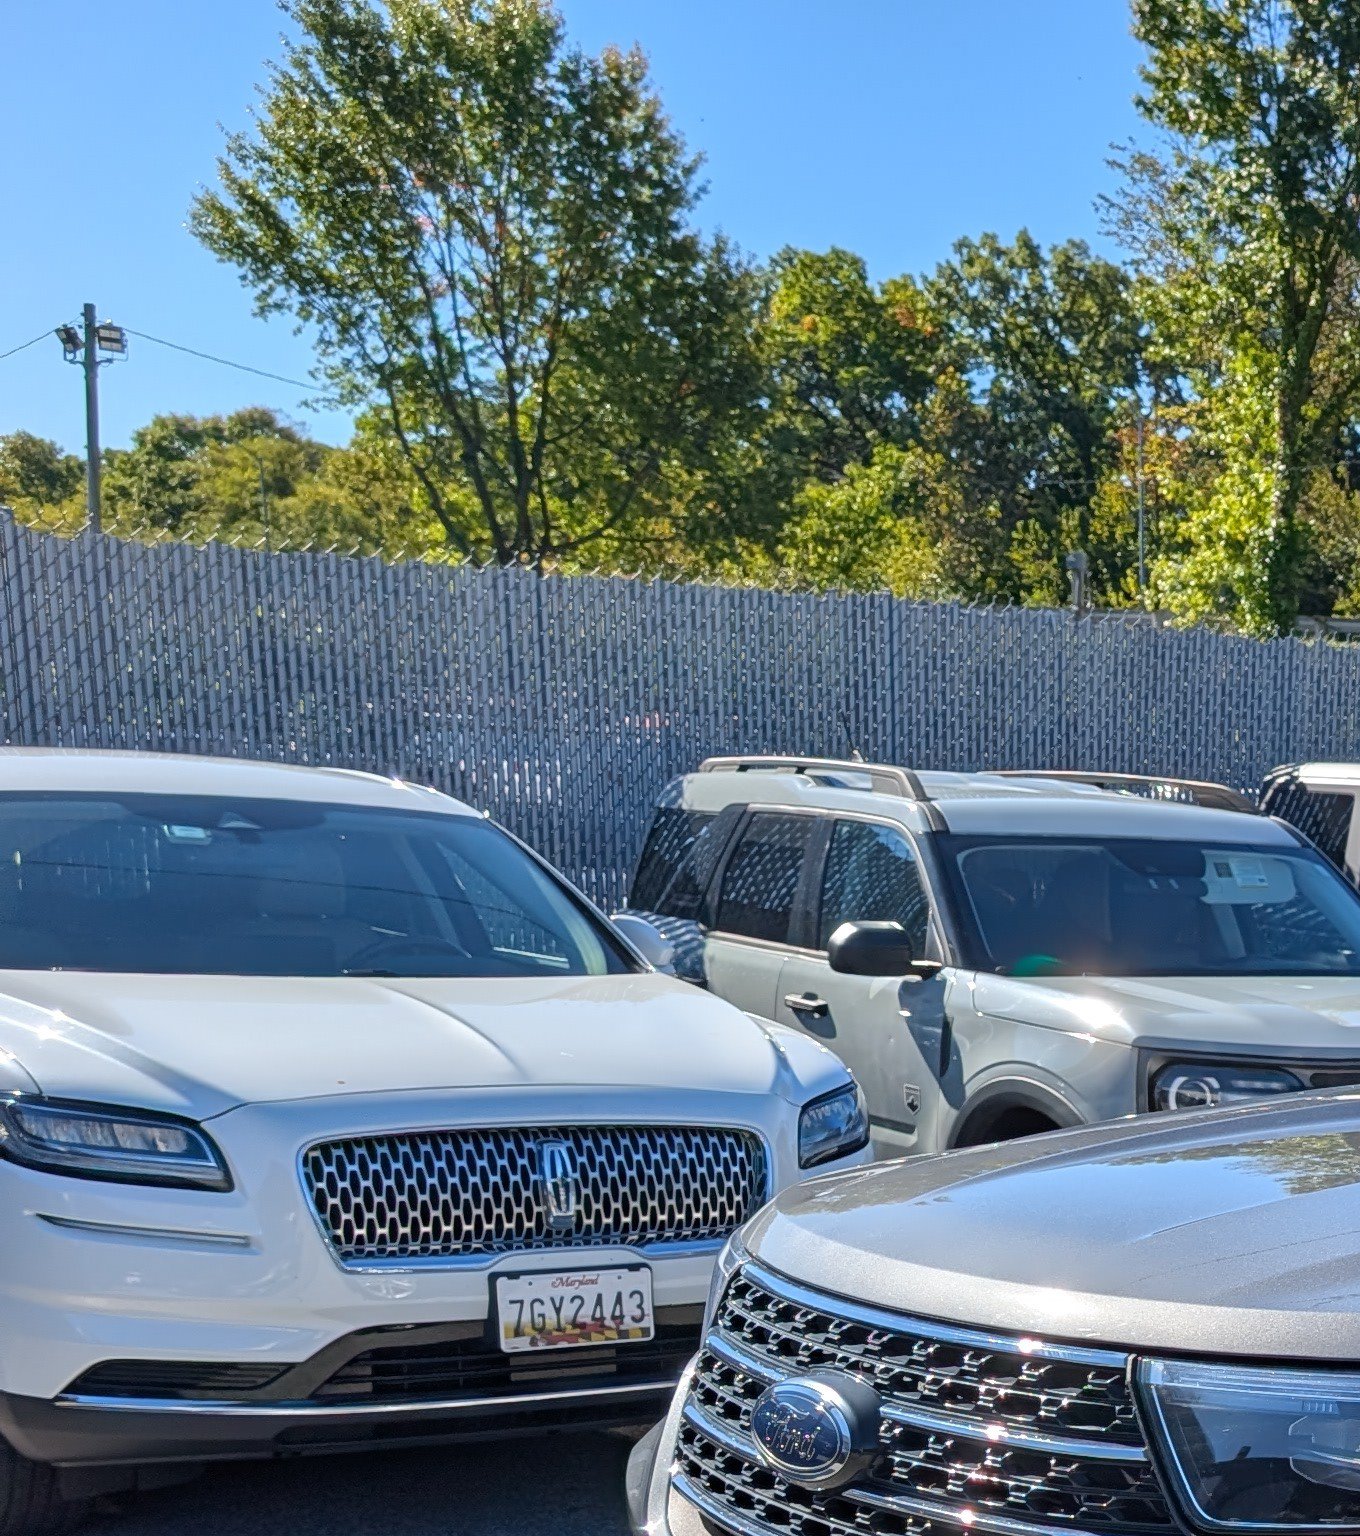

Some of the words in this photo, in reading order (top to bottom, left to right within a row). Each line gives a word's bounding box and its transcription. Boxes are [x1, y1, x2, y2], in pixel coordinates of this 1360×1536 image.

[551, 1274, 599, 1289] Maryland
[508, 1289, 645, 1338] 7GY2443
[760, 1401, 821, 1461] Ford
